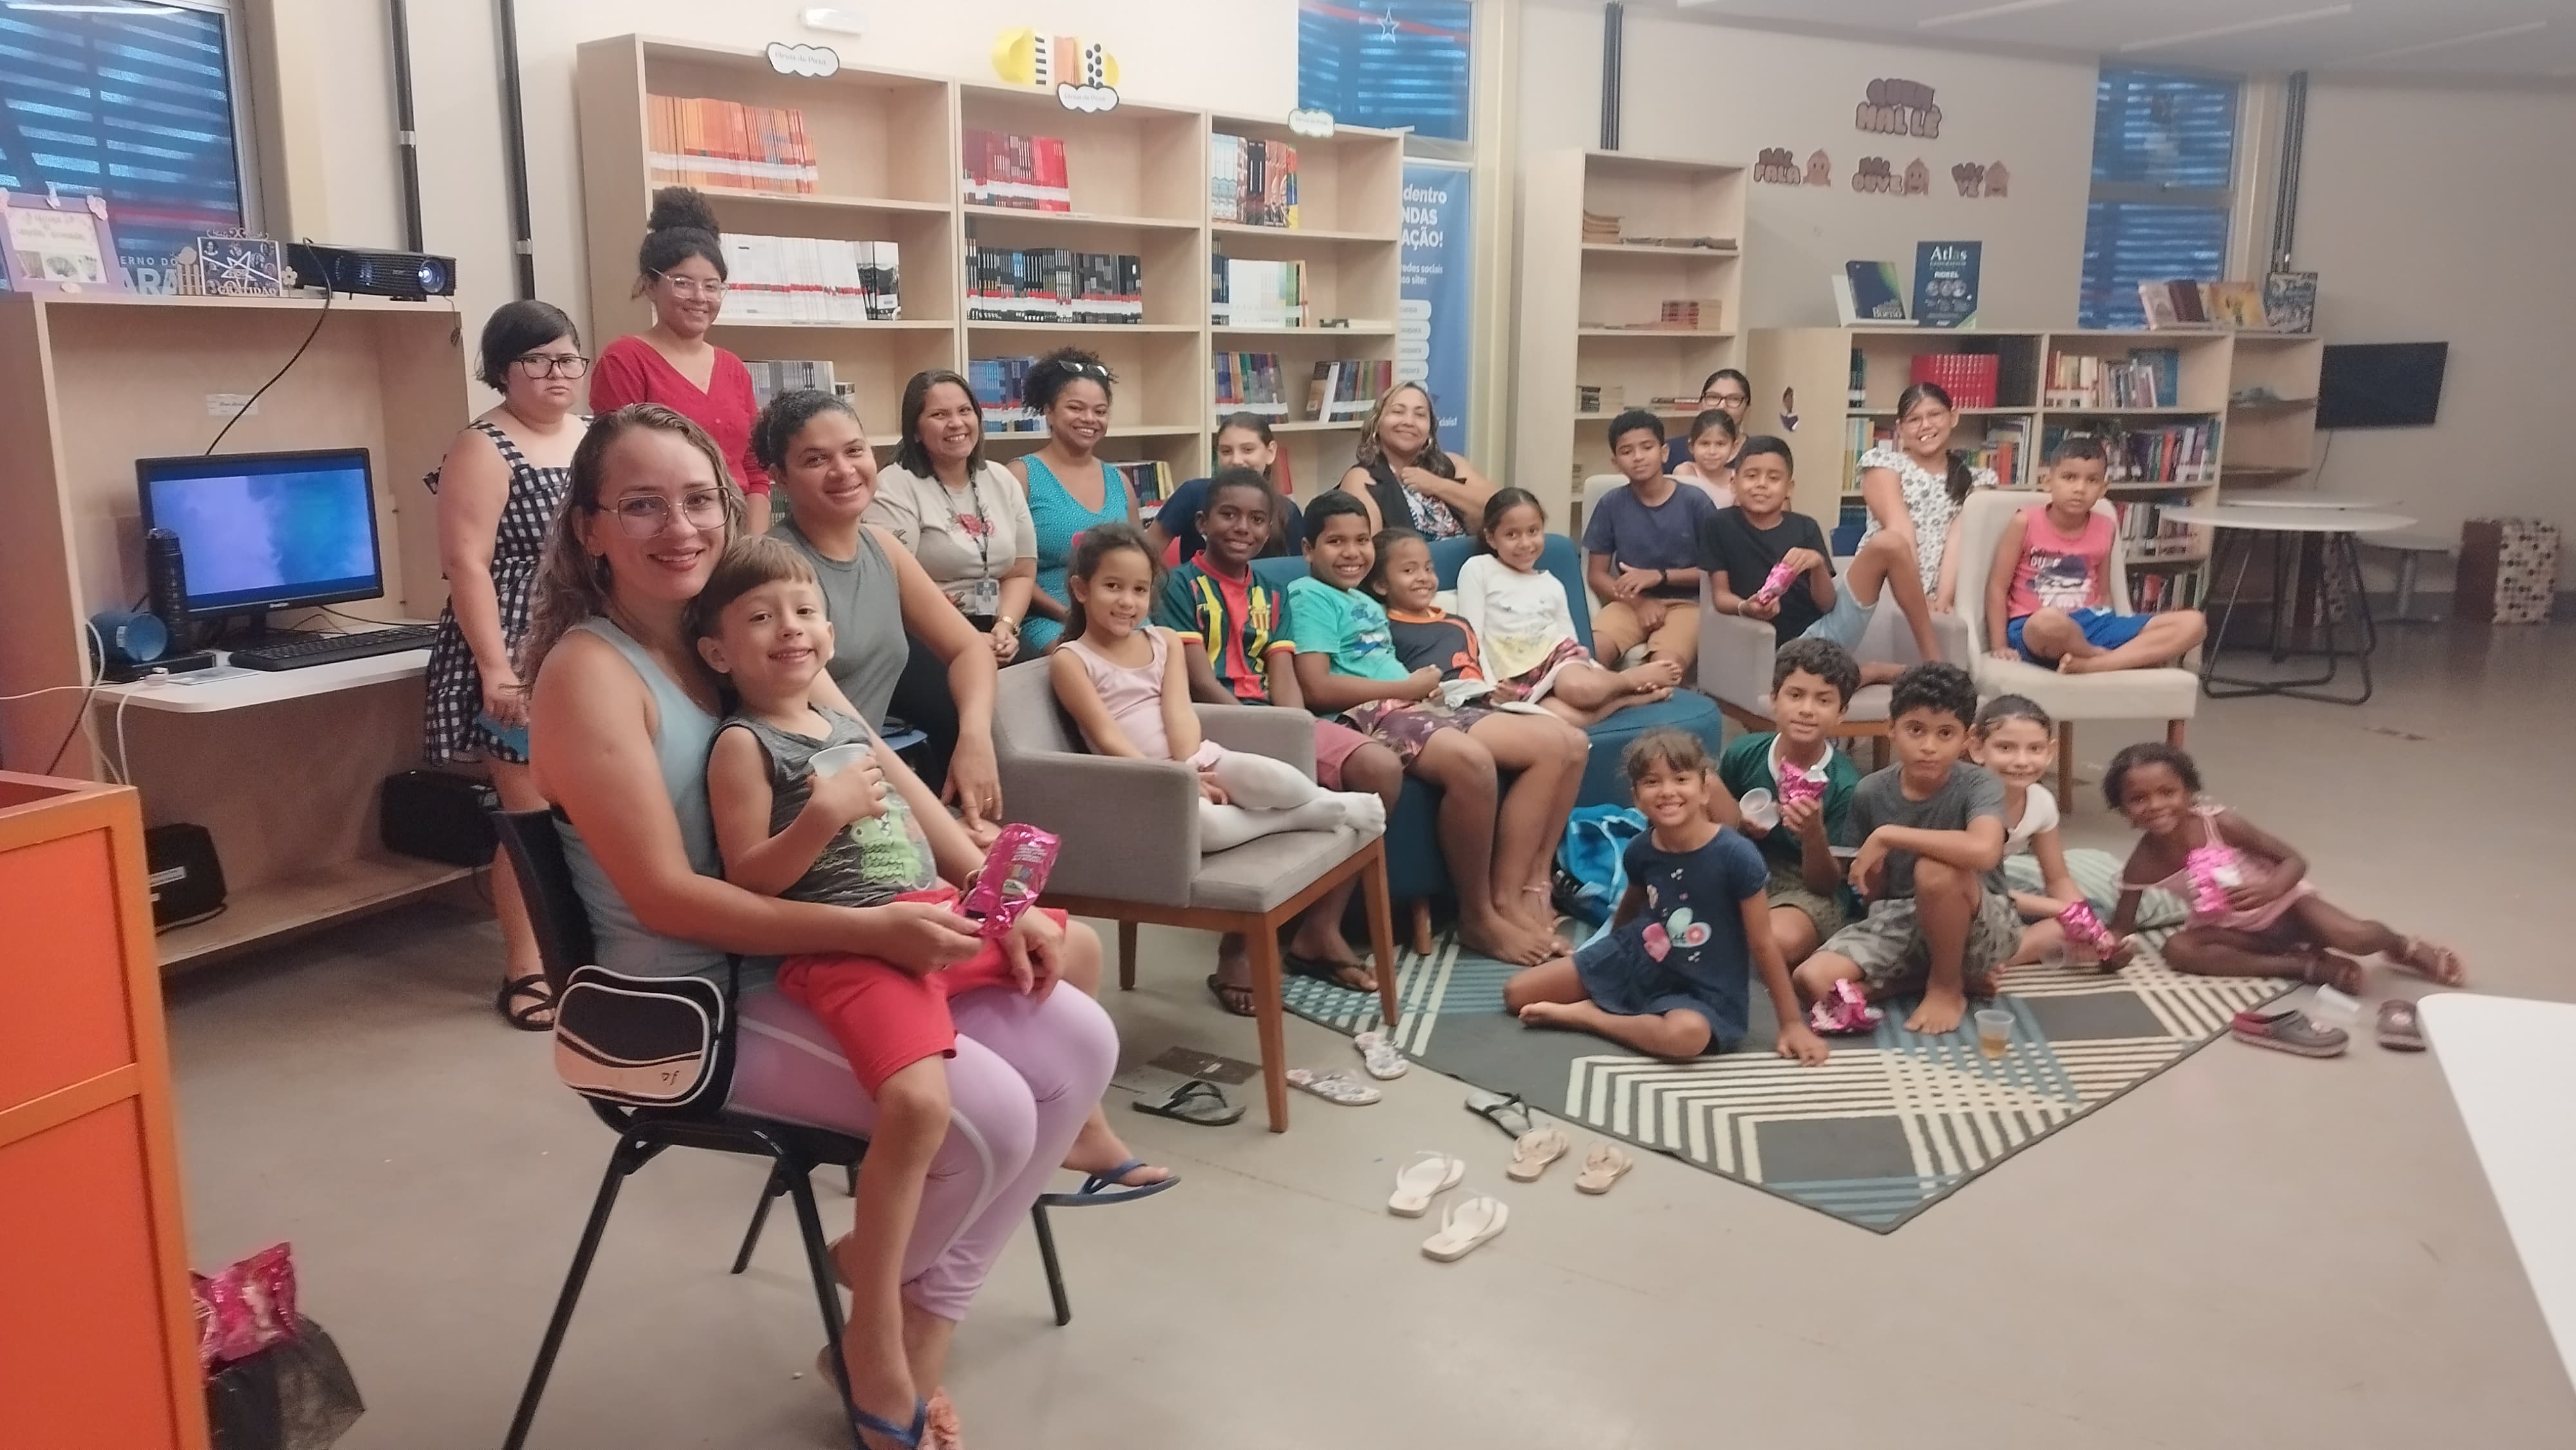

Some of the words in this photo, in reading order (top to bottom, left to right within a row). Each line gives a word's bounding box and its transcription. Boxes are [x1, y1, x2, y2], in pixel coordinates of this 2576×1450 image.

[1855, 101, 1908, 136] MAL
[1754, 162, 1801, 185] FALA
[1852, 172, 1903, 193] OUVE
[1403, 183, 1448, 204] dentro
[1401, 225, 1444, 251] AÇÃO!
[120, 256, 155, 265] ERNO
[161, 257, 178, 265] DO
[1930, 245, 1968, 261] Atlas
[1401, 261, 1420, 273] edes
[1421, 263, 1443, 274] sociais
[1437, 417, 1457, 426] ciais!
